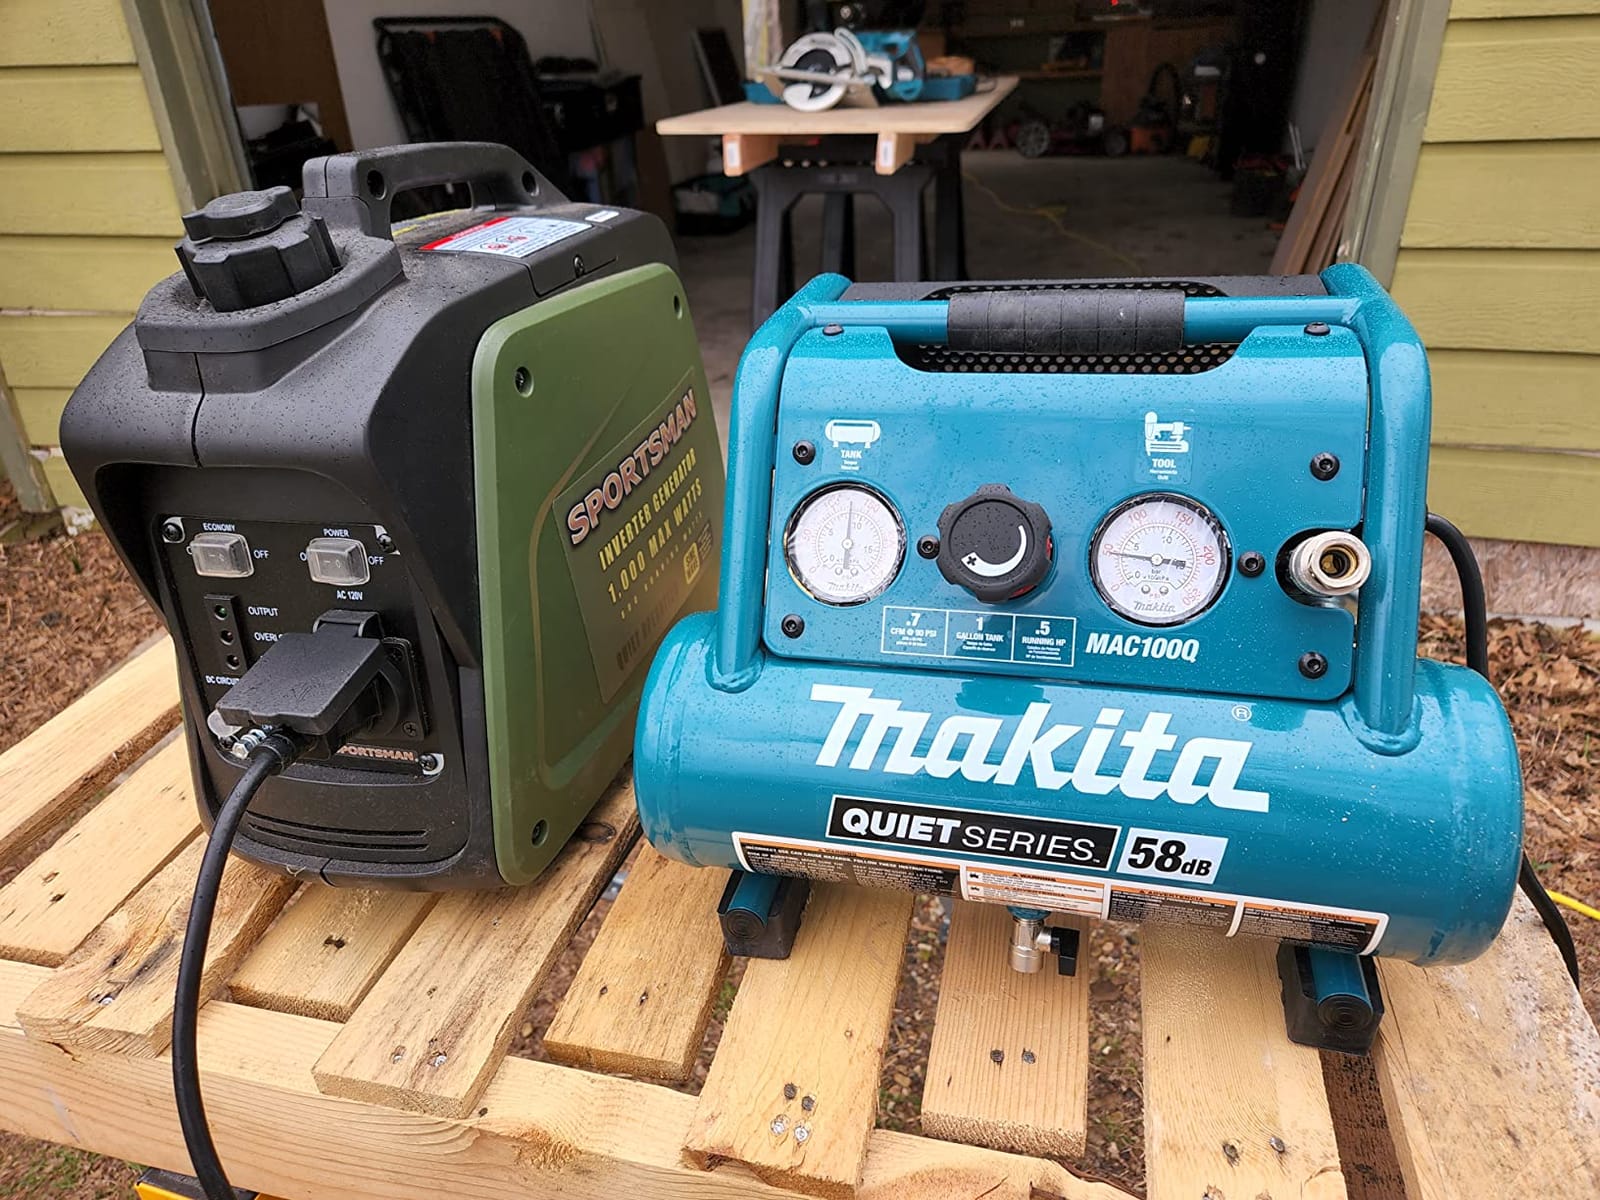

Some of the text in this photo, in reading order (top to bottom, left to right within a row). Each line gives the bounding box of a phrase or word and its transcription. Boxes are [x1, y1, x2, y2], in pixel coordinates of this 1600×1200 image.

[841, 449, 863, 459] TANK
[566, 388, 698, 545] SPORTSMAN
[1152, 458, 1177, 468] TOOL
[598, 503, 653, 571] INVERTER
[652, 447, 697, 512] GENERATOR
[648, 518, 673, 559] MAX
[673, 478, 703, 528] WATTS
[1128, 508, 1147, 523] 100
[1175, 510, 1194, 526] 150
[202, 522, 236, 532] ECONOMY
[323, 528, 350, 538] POWER
[1103, 543, 1114, 556] 50
[1133, 543, 1140, 551] 5
[253, 549, 270, 559] OFF
[1203, 545, 1216, 566] 200
[368, 556, 385, 566] OFF
[1134, 570, 1141, 579] 0
[336, 590, 364, 601] AC 120V
[247, 606, 279, 617] OUTPUT
[905, 612, 921, 627] .7
[975, 616, 985, 631] 1
[890, 627, 906, 636] CFM
[925, 629, 937, 638] PSI
[1034, 620, 1051, 636] .5
[955, 631, 1004, 642] GALLON TANK
[1021, 636, 1067, 647] RUNNING HP
[1085, 632, 1200, 664] MAC100Q
[205, 675, 216, 685] DC
[841, 807, 962, 844] QUIET
